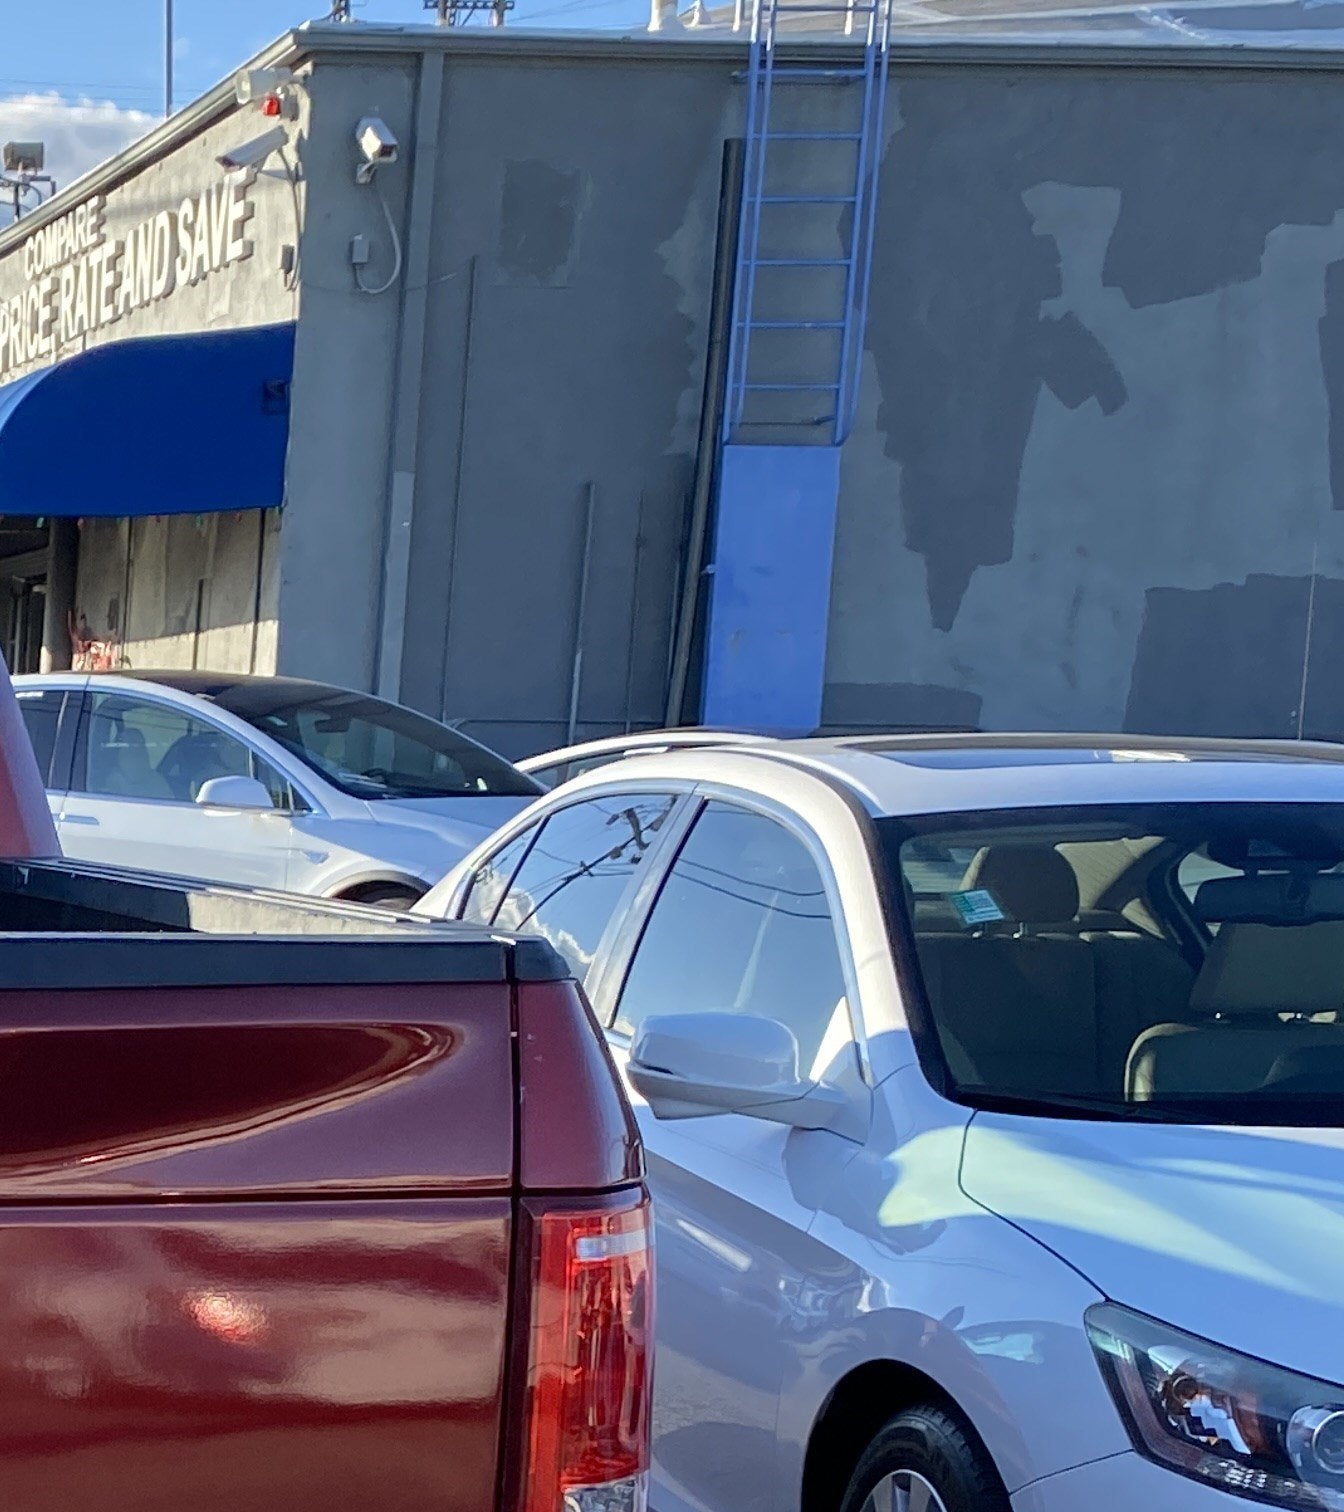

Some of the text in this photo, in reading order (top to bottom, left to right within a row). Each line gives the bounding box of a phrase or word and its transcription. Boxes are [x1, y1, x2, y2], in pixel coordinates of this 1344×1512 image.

[24, 196, 102, 281] COMPARE
[61, 240, 120, 343] RATE
[118, 210, 174, 315] AND
[175, 168, 250, 288] SAVE
